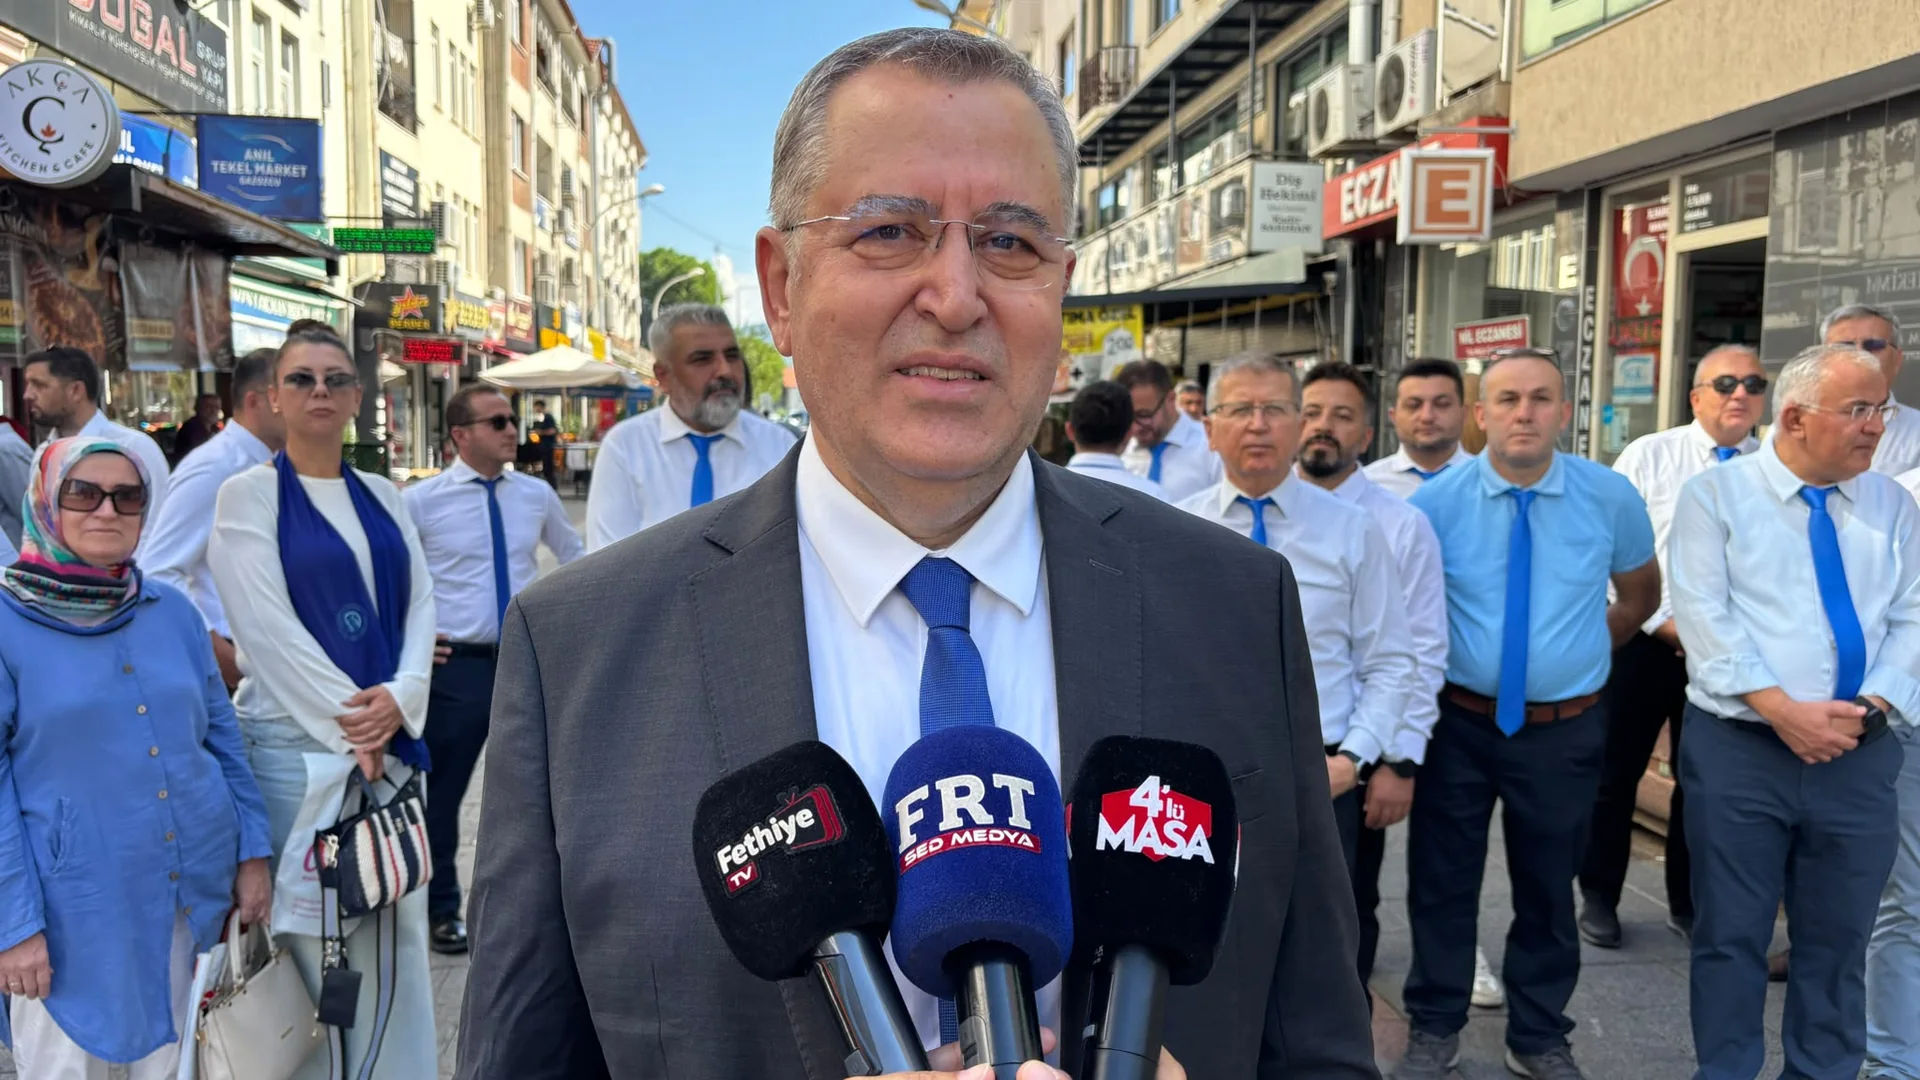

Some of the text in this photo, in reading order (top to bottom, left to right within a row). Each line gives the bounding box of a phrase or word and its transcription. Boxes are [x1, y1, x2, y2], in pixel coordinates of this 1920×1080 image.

[210, 159, 308, 178] TEKEL MARKET
[894, 774, 1036, 855] FRT
[1094, 811, 1215, 865] MASA
[715, 806, 815, 874] Fethiye
[902, 828, 1036, 870] SED MEDYA
[729, 865, 753, 888] TV
